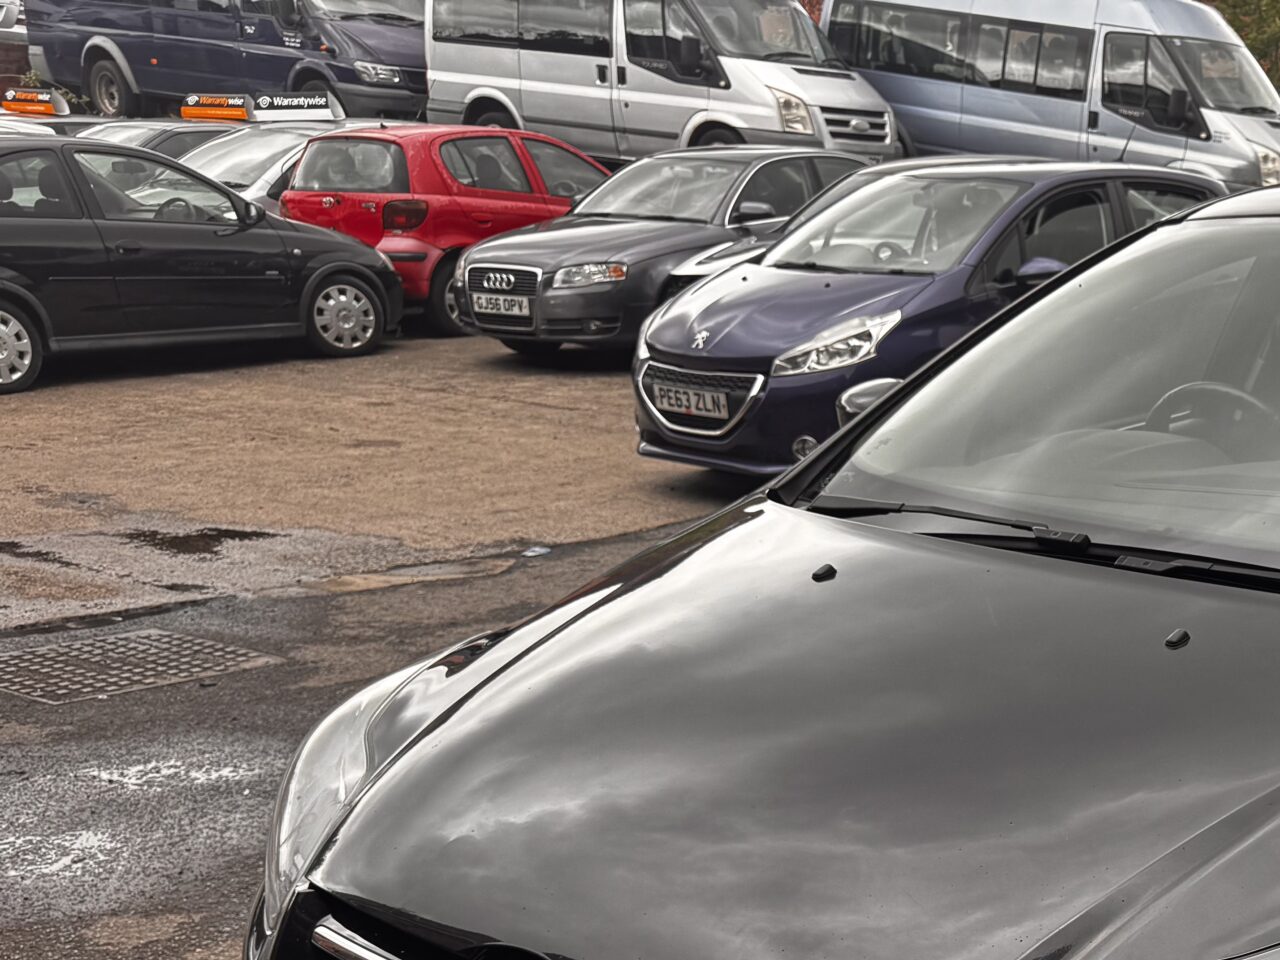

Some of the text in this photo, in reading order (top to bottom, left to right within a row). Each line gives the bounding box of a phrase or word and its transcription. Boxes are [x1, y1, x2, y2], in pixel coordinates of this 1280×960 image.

[199, 96, 244, 107] Warrantywise
[273, 96, 327, 107] Warrantywise
[659, 387, 722, 414] PE63 ZLN
